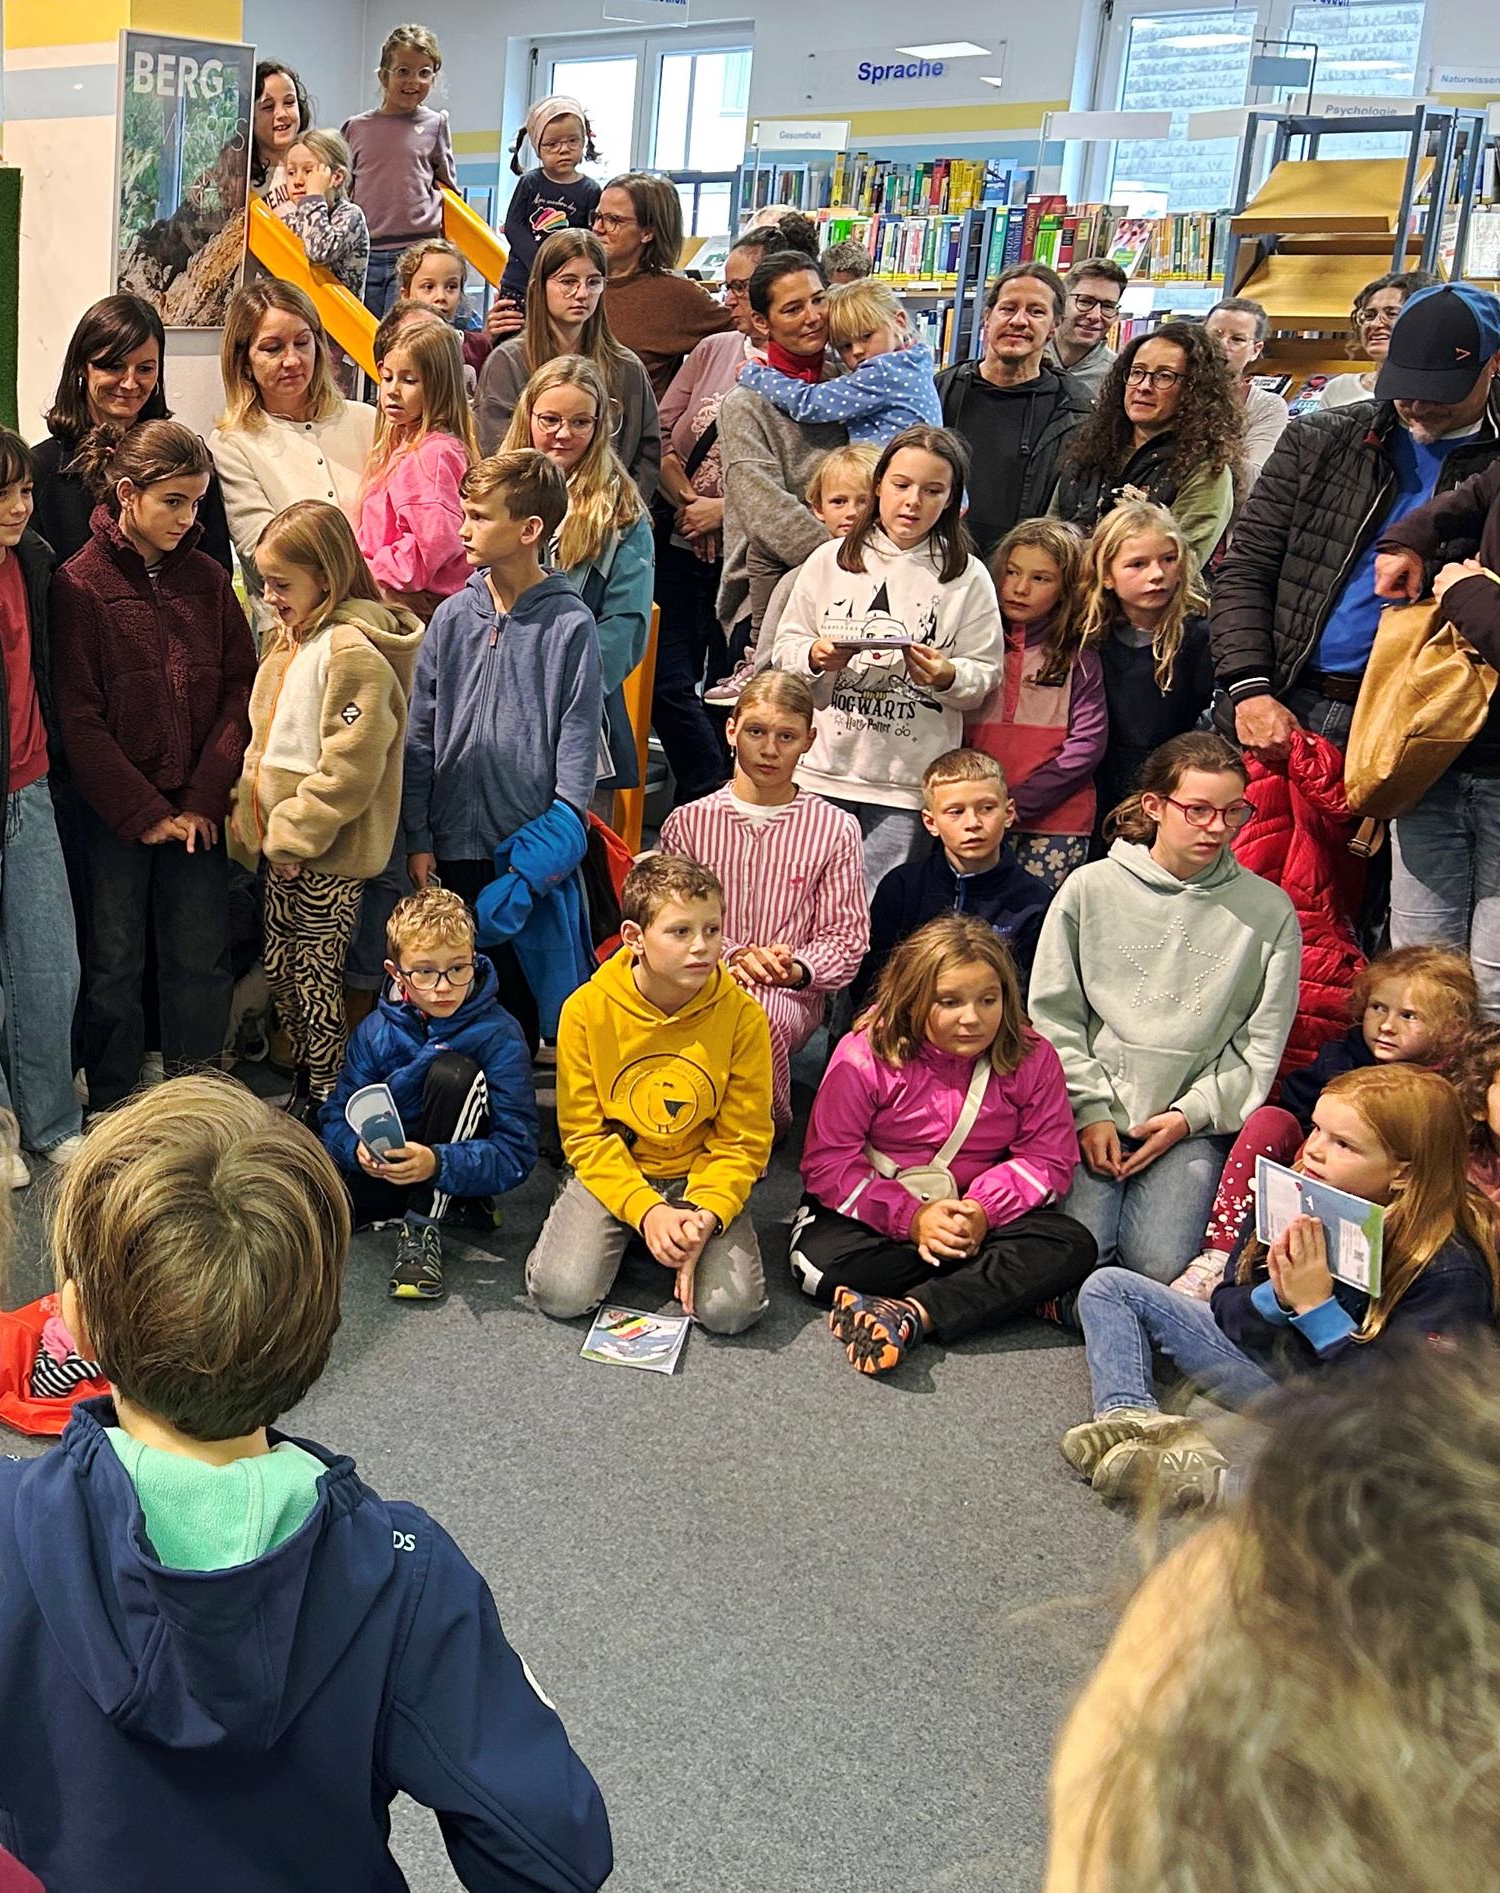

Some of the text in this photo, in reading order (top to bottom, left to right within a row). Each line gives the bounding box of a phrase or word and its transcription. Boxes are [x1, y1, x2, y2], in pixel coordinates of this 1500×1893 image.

[133, 51, 224, 100] BERG
[857, 58, 944, 85] Sprache
[1325, 104, 1398, 116] Psychologie
[779, 130, 822, 140] Gesundheit
[1025, 208, 1037, 246] ANATOMICA
[831, 692, 916, 721] HOGWARTS
